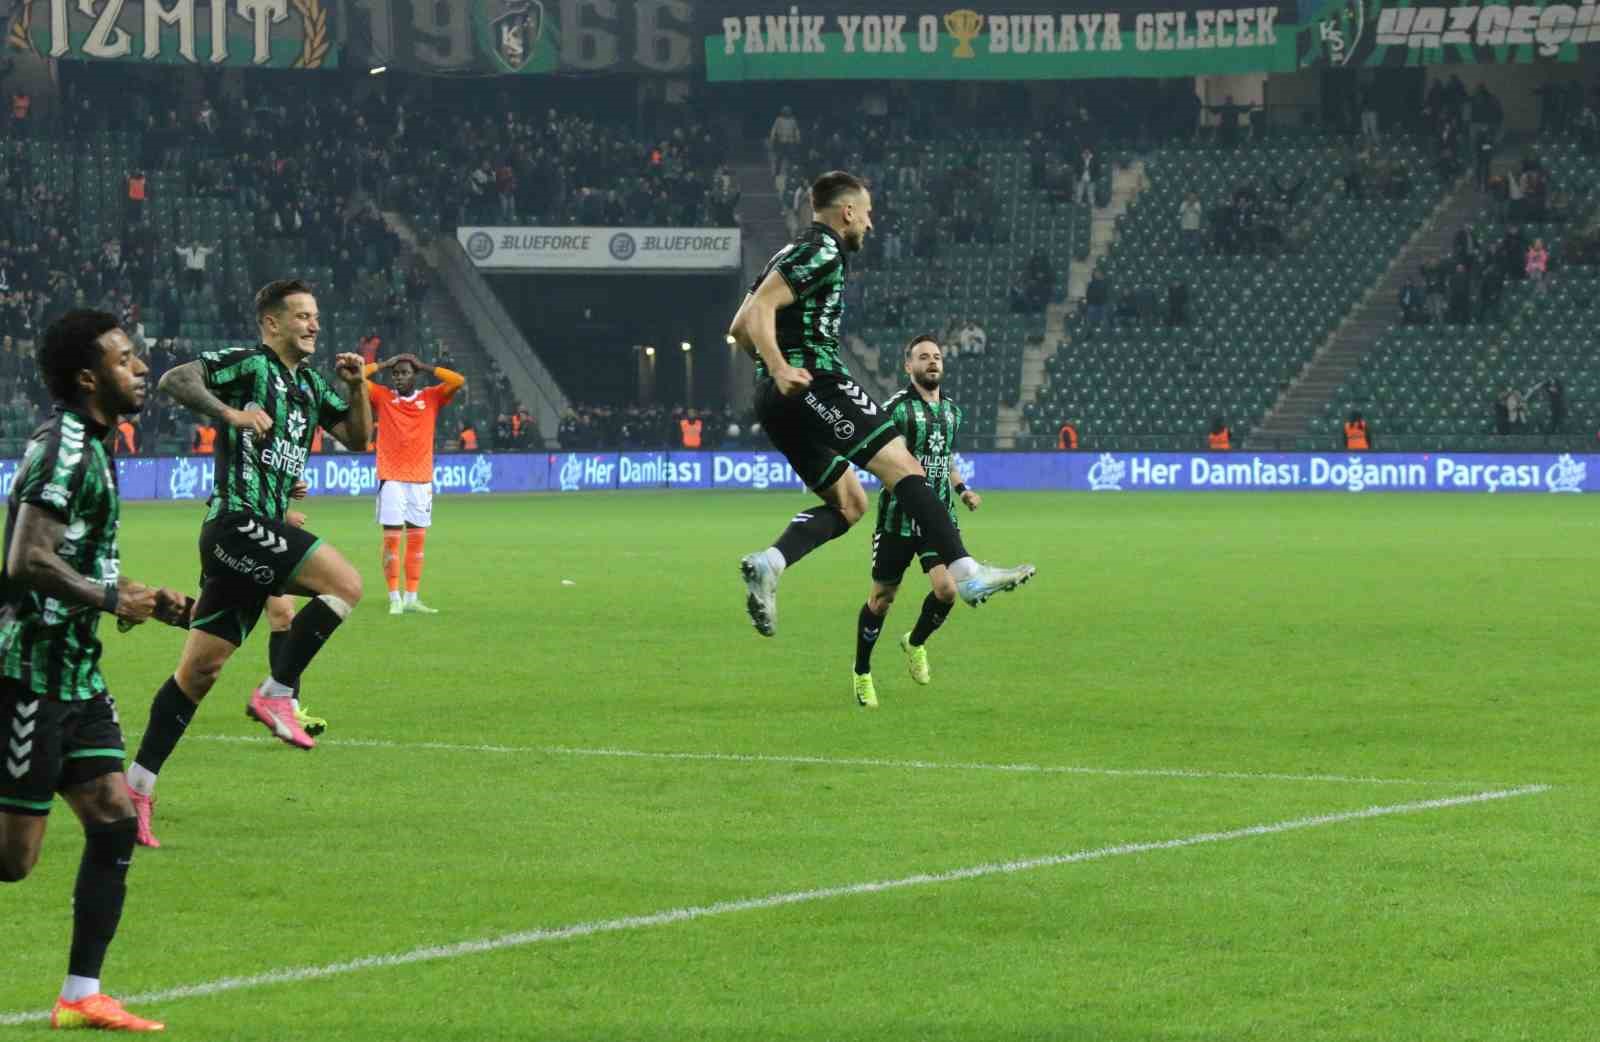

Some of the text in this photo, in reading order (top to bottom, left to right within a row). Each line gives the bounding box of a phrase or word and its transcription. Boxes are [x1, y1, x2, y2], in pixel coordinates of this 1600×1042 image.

[722, 6, 1279, 54] PANİK YOK O BURAYA GELECEK
[584, 458, 616, 483] Her
[619, 457, 701, 482] Damlası
[1131, 457, 1183, 485] Her
[1309, 456, 1426, 491] Doğanın
[1436, 457, 1540, 493] Parçası
